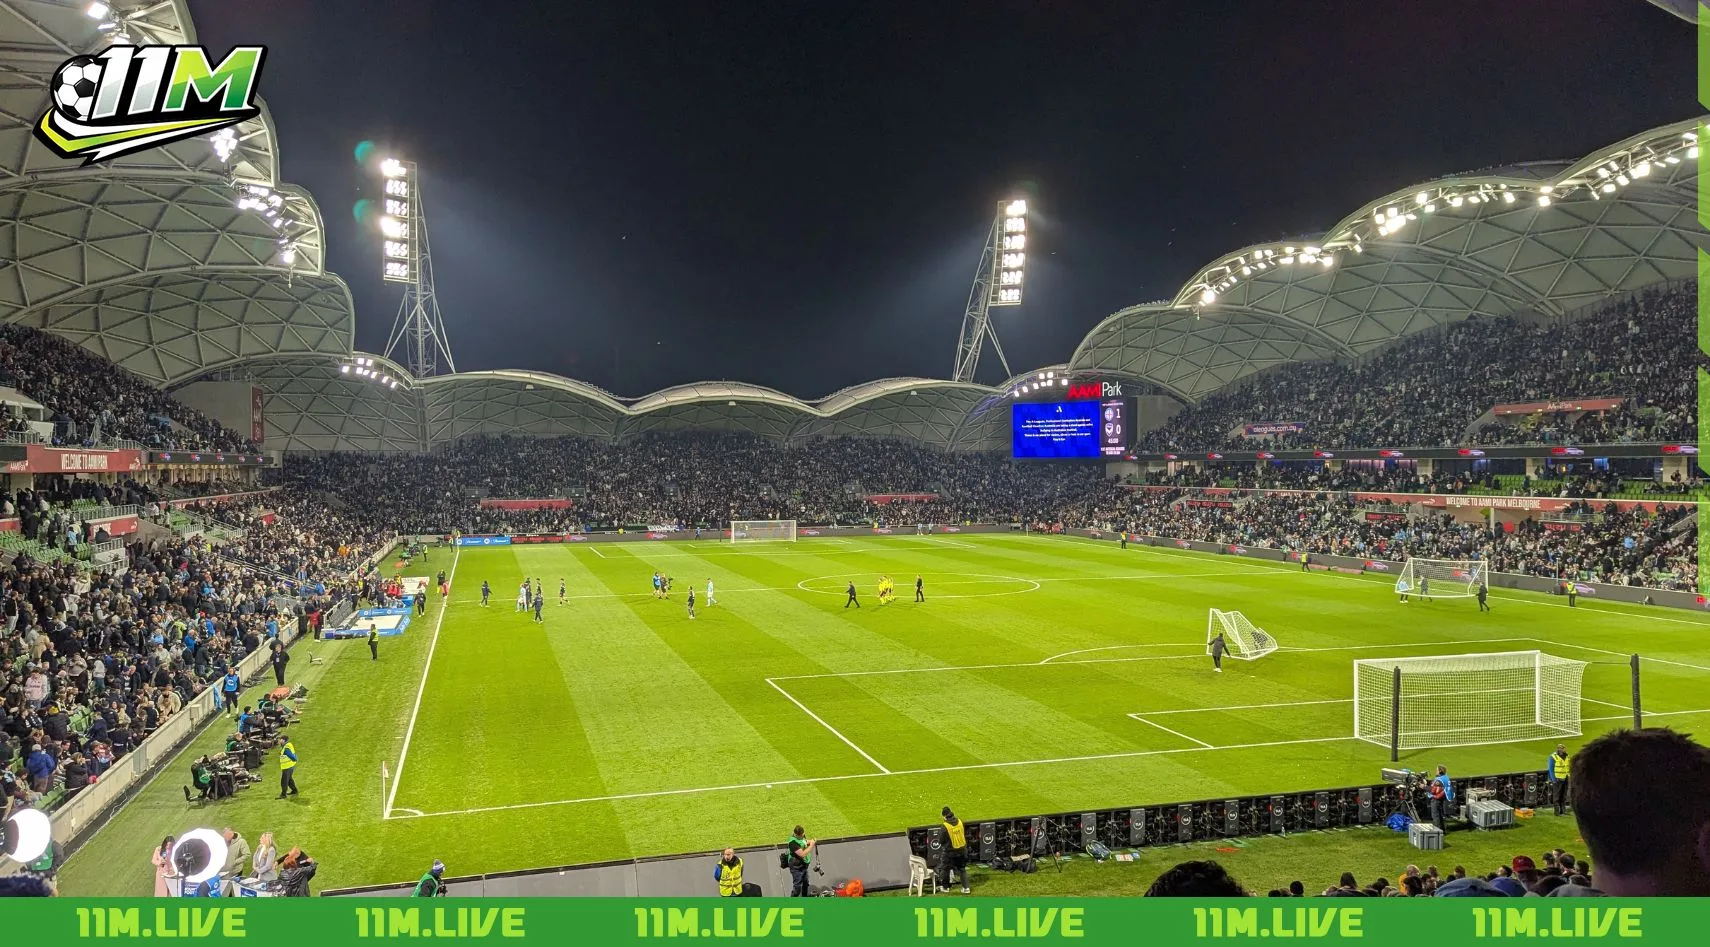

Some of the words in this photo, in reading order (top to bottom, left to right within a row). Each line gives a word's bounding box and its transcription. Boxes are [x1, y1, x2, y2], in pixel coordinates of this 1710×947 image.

[1066, 383, 1101, 400] AAMI
[1102, 381, 1122, 397] Park
[1116, 408, 1121, 419] 1
[1116, 424, 1121, 435] 0
[61, 453, 82, 470] WELCOME
[82, 454, 88, 470] TO
[1446, 496, 1470, 506] WELCOME
[1470, 497, 1478, 506] TO
[1478, 497, 1492, 507] AAMI
[1492, 498, 1507, 507] PARK
[1507, 498, 1541, 509] MELBOURNE
